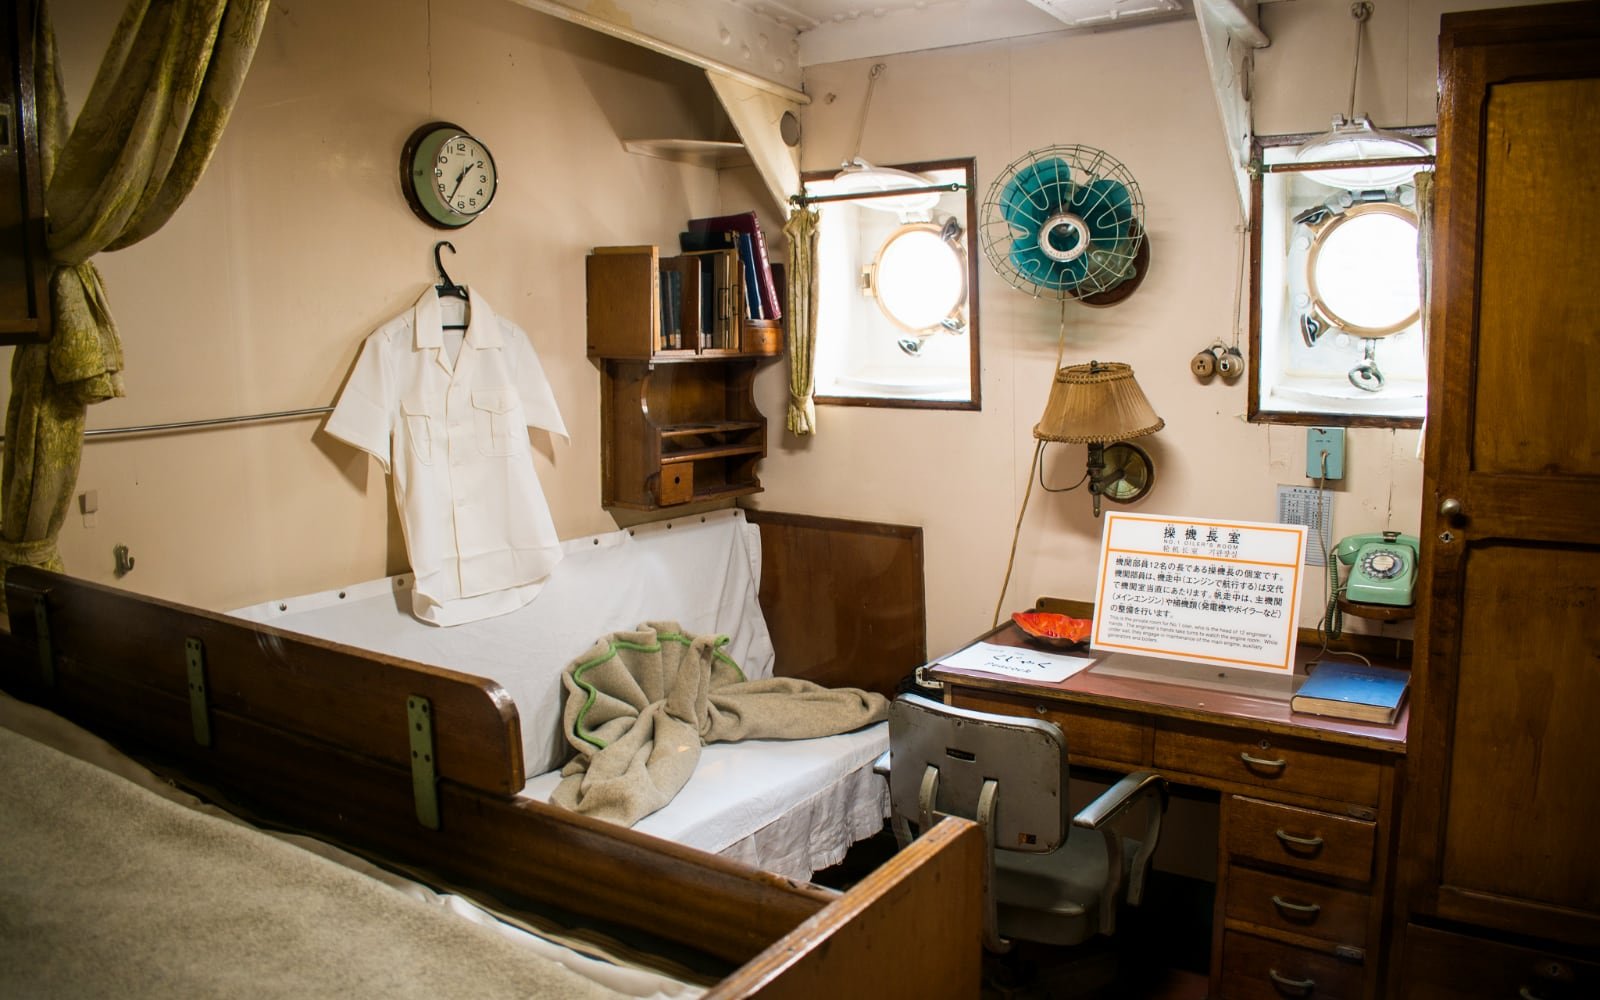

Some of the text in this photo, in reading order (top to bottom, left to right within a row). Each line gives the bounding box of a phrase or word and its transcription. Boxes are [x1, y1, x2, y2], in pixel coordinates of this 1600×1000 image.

[447, 146, 453, 154] 11
[439, 156, 448, 164] 10
[476, 161, 483, 169] 2
[436, 169, 442, 177] 9
[439, 184, 445, 192] 8
[458, 201, 465, 209] 6
[470, 198, 476, 206] 5
